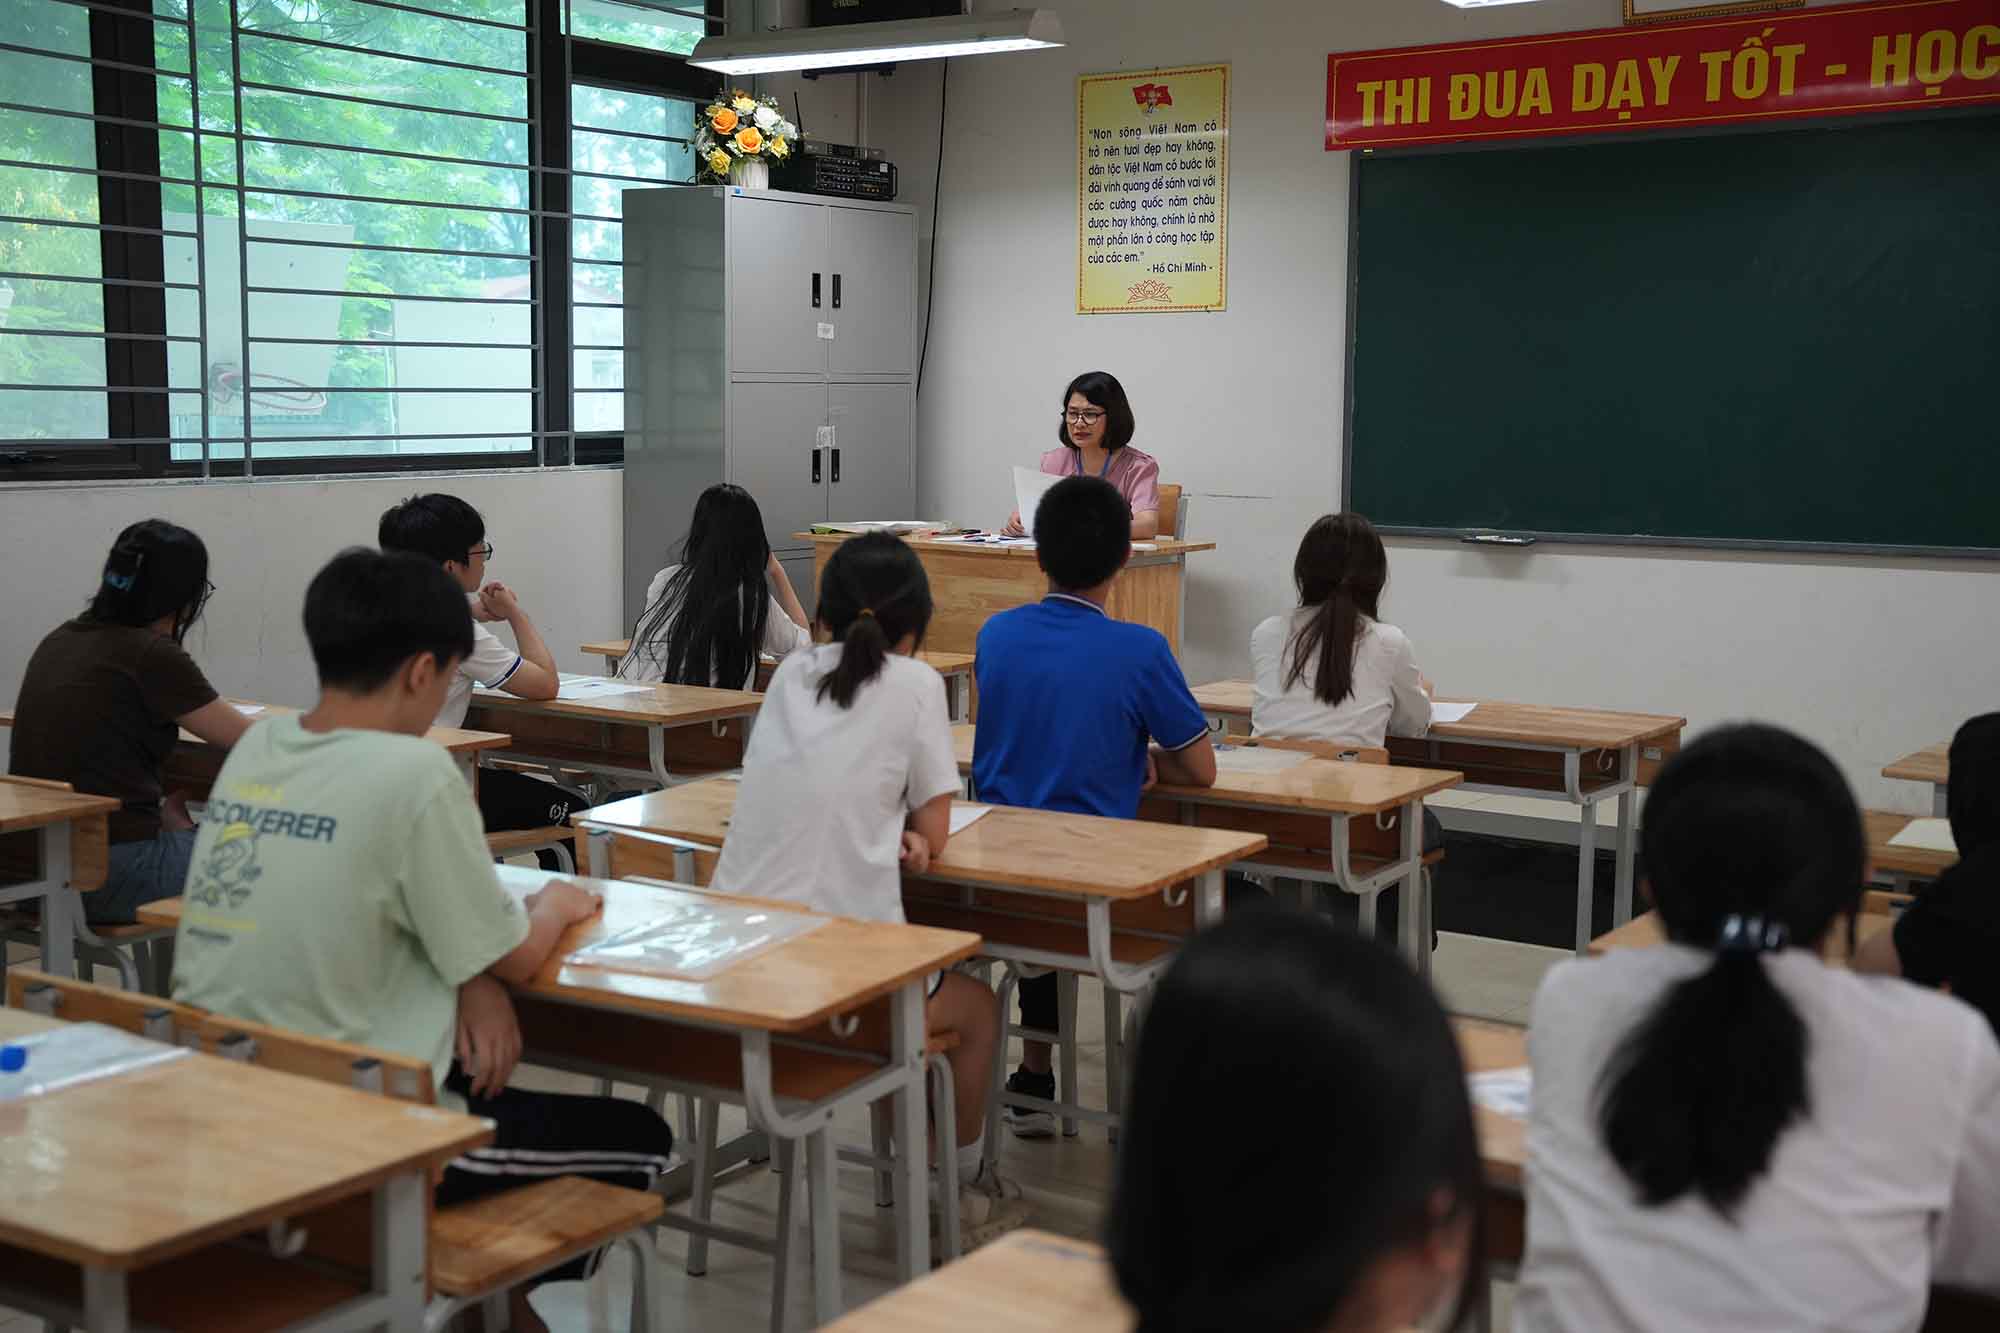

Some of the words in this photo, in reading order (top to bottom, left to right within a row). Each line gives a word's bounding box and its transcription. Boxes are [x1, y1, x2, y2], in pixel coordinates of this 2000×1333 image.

[1356, 76, 1432, 127] THI
[1448, 66, 1553, 121] ĐUA
[1571, 55, 1681, 120] DẠY
[1699, 27, 1806, 102] TỐT
[1825, 63, 1847, 76] -
[1870, 24, 2000, 97] HỌC
[1119, 126, 1141, 140] sông
[1149, 124, 1168, 136] Việt
[1174, 123, 1198, 134] Nam
[1203, 119, 1217, 132] có
[1088, 144, 1100, 158] trở
[1103, 145, 1120, 157] nên
[1124, 144, 1140, 156] tươi
[1144, 143, 1162, 156] đẹp
[1166, 142, 1182, 154] hay
[1088, 163, 1105, 176] dân
[1107, 162, 1121, 176] tộc
[1124, 161, 1140, 175] Việt
[1142, 161, 1163, 173] Nam
[1165, 159, 1178, 171] có
[1180, 158, 1202, 170] bước
[1205, 156, 1216, 169] tới
[1088, 181, 1102, 194] đài
[1104, 181, 1121, 193] vinh
[1122, 182, 1150, 194] quang
[1151, 176, 1164, 190] để
[1165, 177, 1186, 189] sánh
[1187, 177, 1201, 188] vai
[1202, 174, 1216, 187] với
[1088, 199, 1105, 211] các
[1109, 197, 1136, 212] cường
[1141, 194, 1164, 211] quốc
[1168, 194, 1188, 207] năm
[1192, 193, 1215, 206] châu
[1088, 217, 1110, 230] được
[1111, 217, 1128, 229] hay
[1130, 215, 1159, 229] không,
[1161, 212, 1185, 225] chính
[1187, 212, 1196, 224] là
[1198, 210, 1216, 224] nhờ
[1088, 234, 1104, 249] một
[1106, 231, 1128, 248] phần
[1131, 232, 1144, 245] lớn
[1146, 230, 1153, 244] ở
[1155, 231, 1178, 246] công
[1180, 231, 1198, 246] học
[1199, 230, 1215, 244] tập
[1088, 250, 1104, 263] của
[1105, 251, 1122, 263] các
[1152, 262, 1166, 273] Hồ
[1184, 262, 1207, 272] Minh
